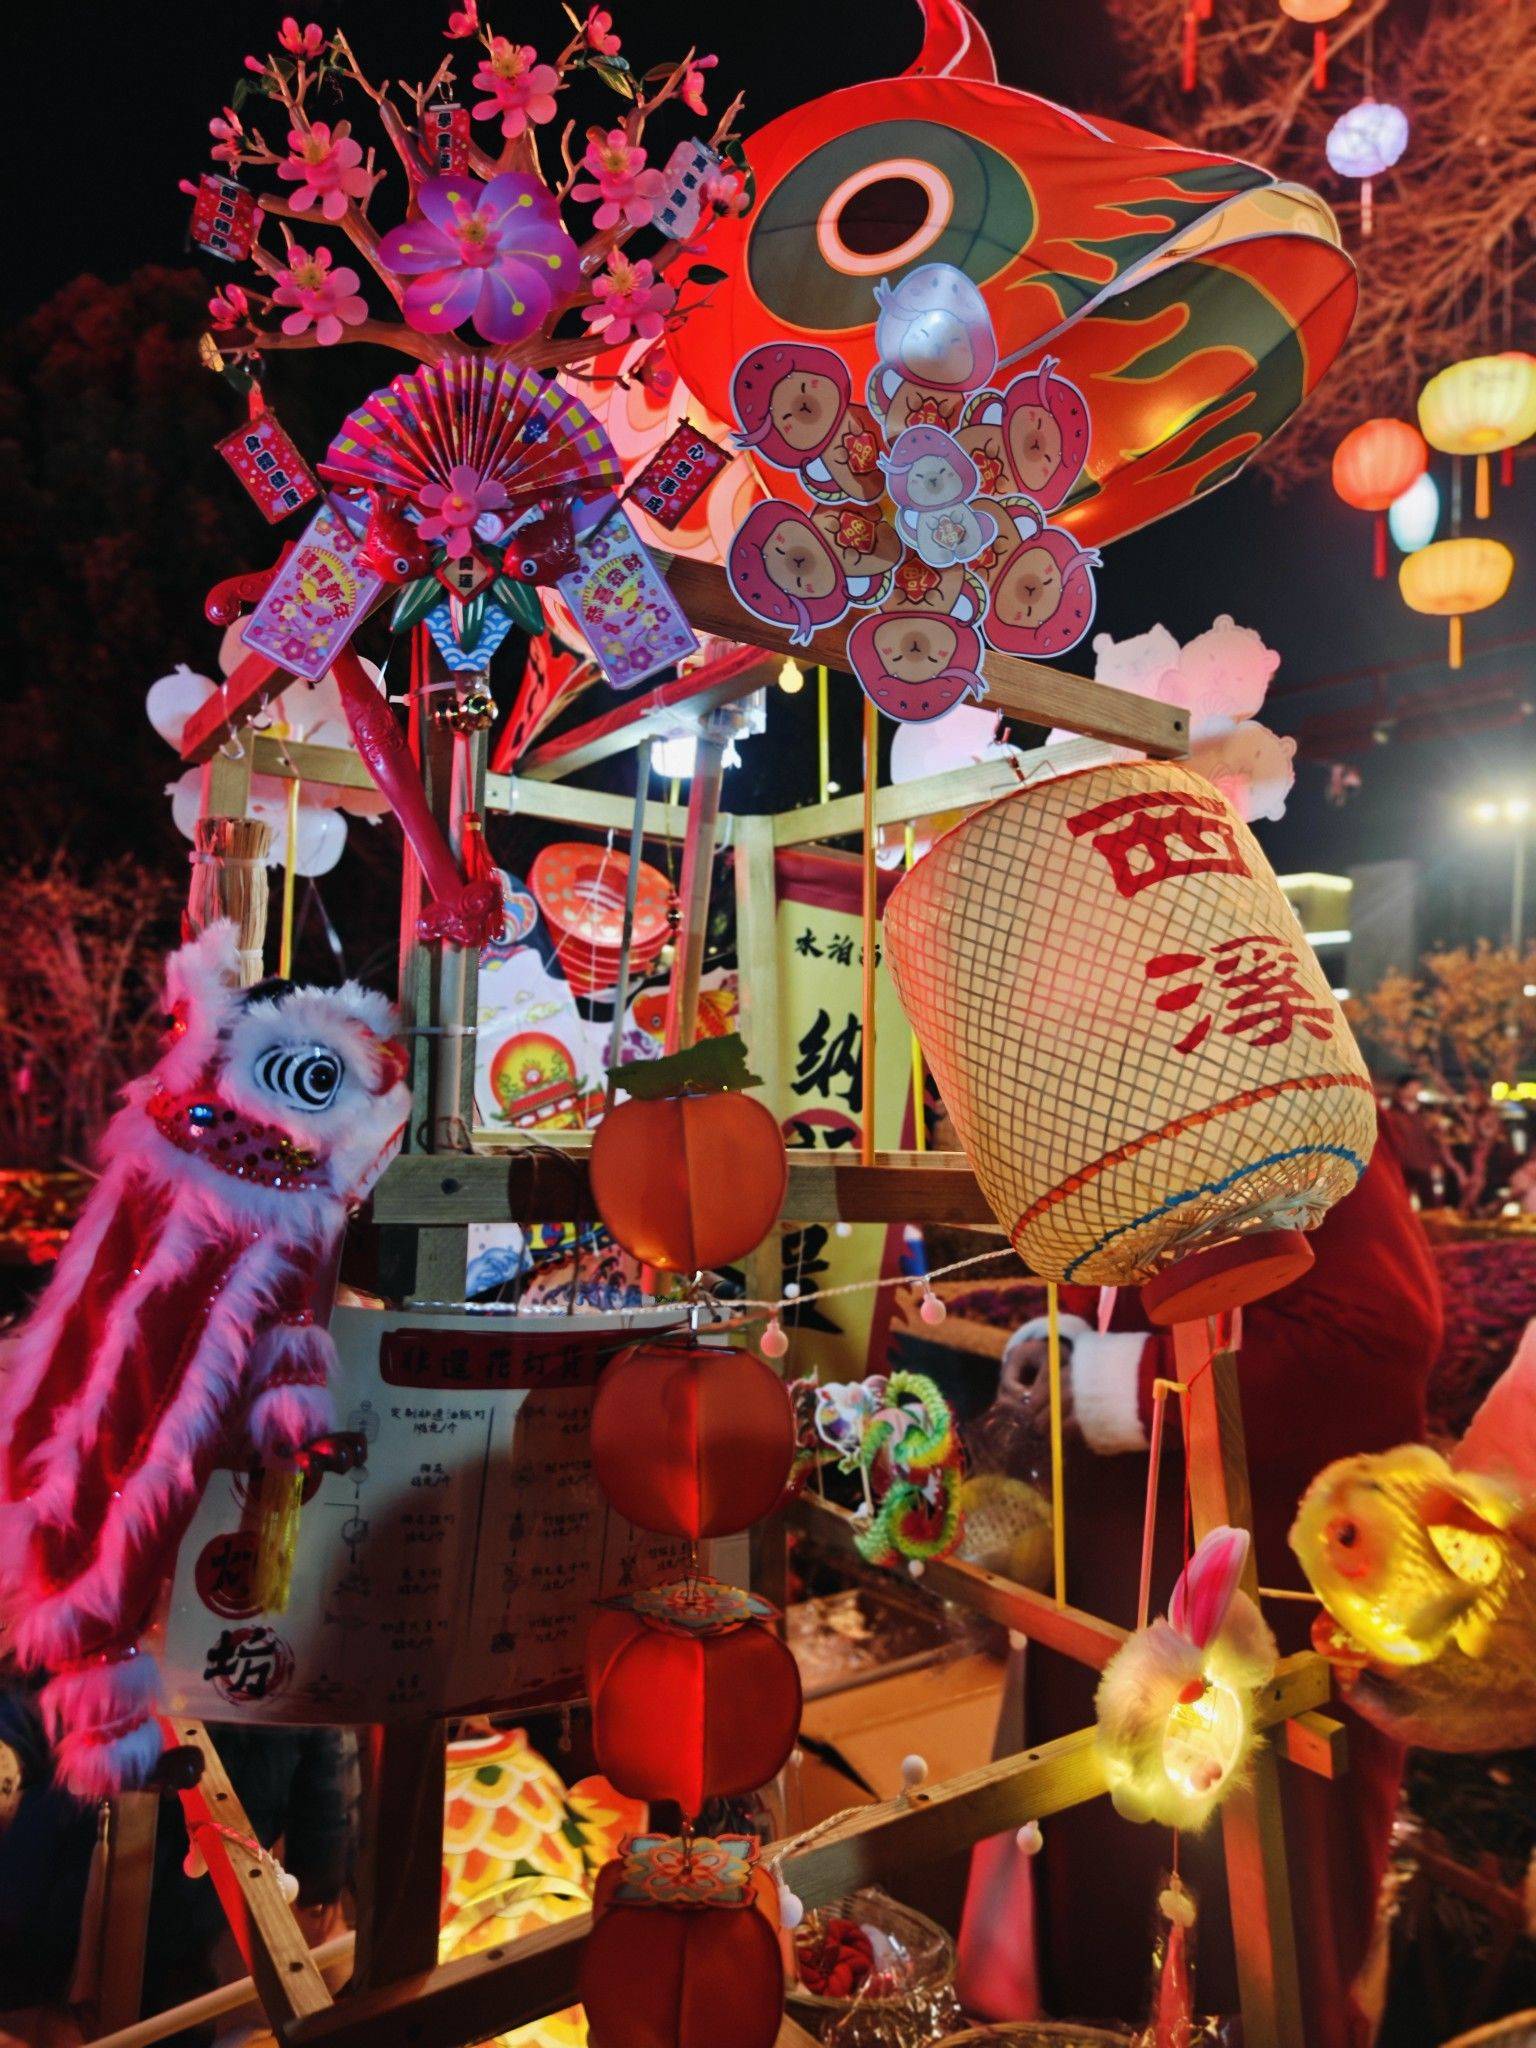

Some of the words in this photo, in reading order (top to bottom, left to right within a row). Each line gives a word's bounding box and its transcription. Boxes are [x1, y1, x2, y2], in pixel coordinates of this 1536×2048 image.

[643, 441, 705, 515] 心想事成
[204, 1626, 278, 1698] 坊
